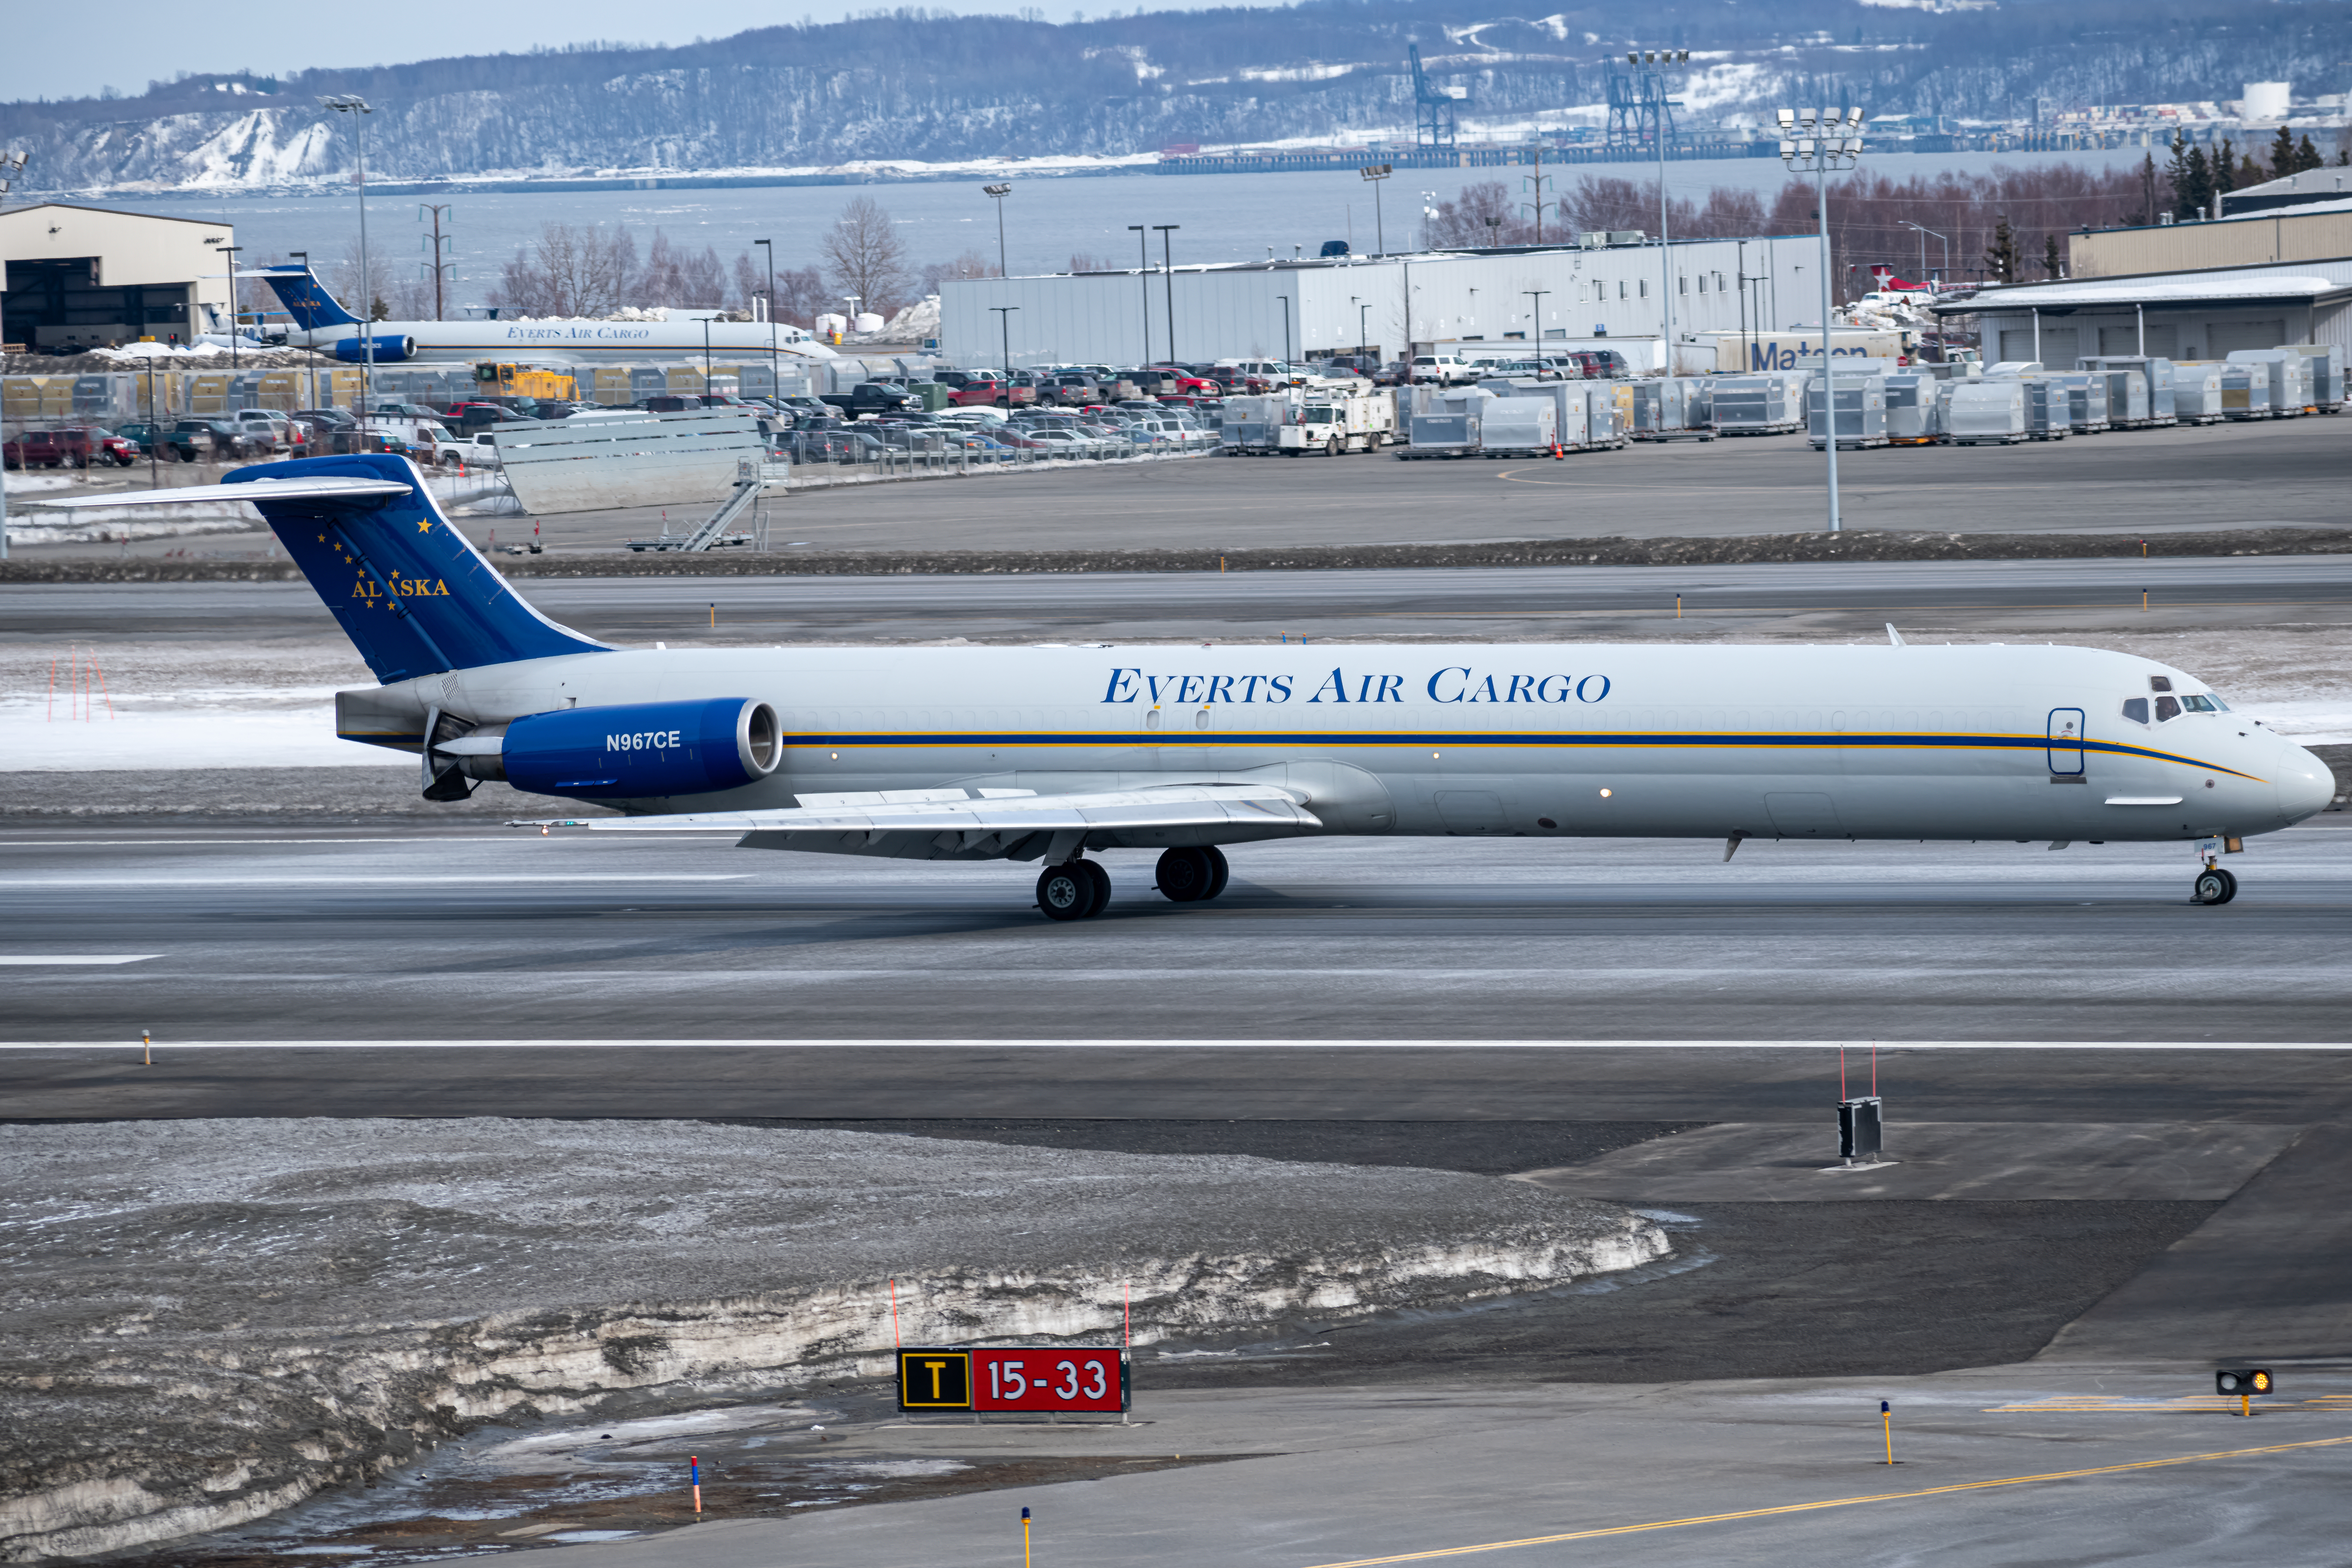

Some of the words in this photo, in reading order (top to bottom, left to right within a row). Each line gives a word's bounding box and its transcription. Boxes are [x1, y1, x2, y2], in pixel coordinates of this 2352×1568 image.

[507, 327, 561, 338] EVERTS
[565, 327, 592, 338] AIR
[598, 327, 649, 339] CARGO
[352, 579, 450, 597] ALASKA
[1100, 668, 1294, 703] EVERTS
[1306, 667, 1404, 703] AIR
[1427, 667, 1611, 703] CARGO
[607, 730, 681, 752] N967CE
[924, 1362, 946, 1399] T
[988, 1360, 1107, 1400] 15-33
